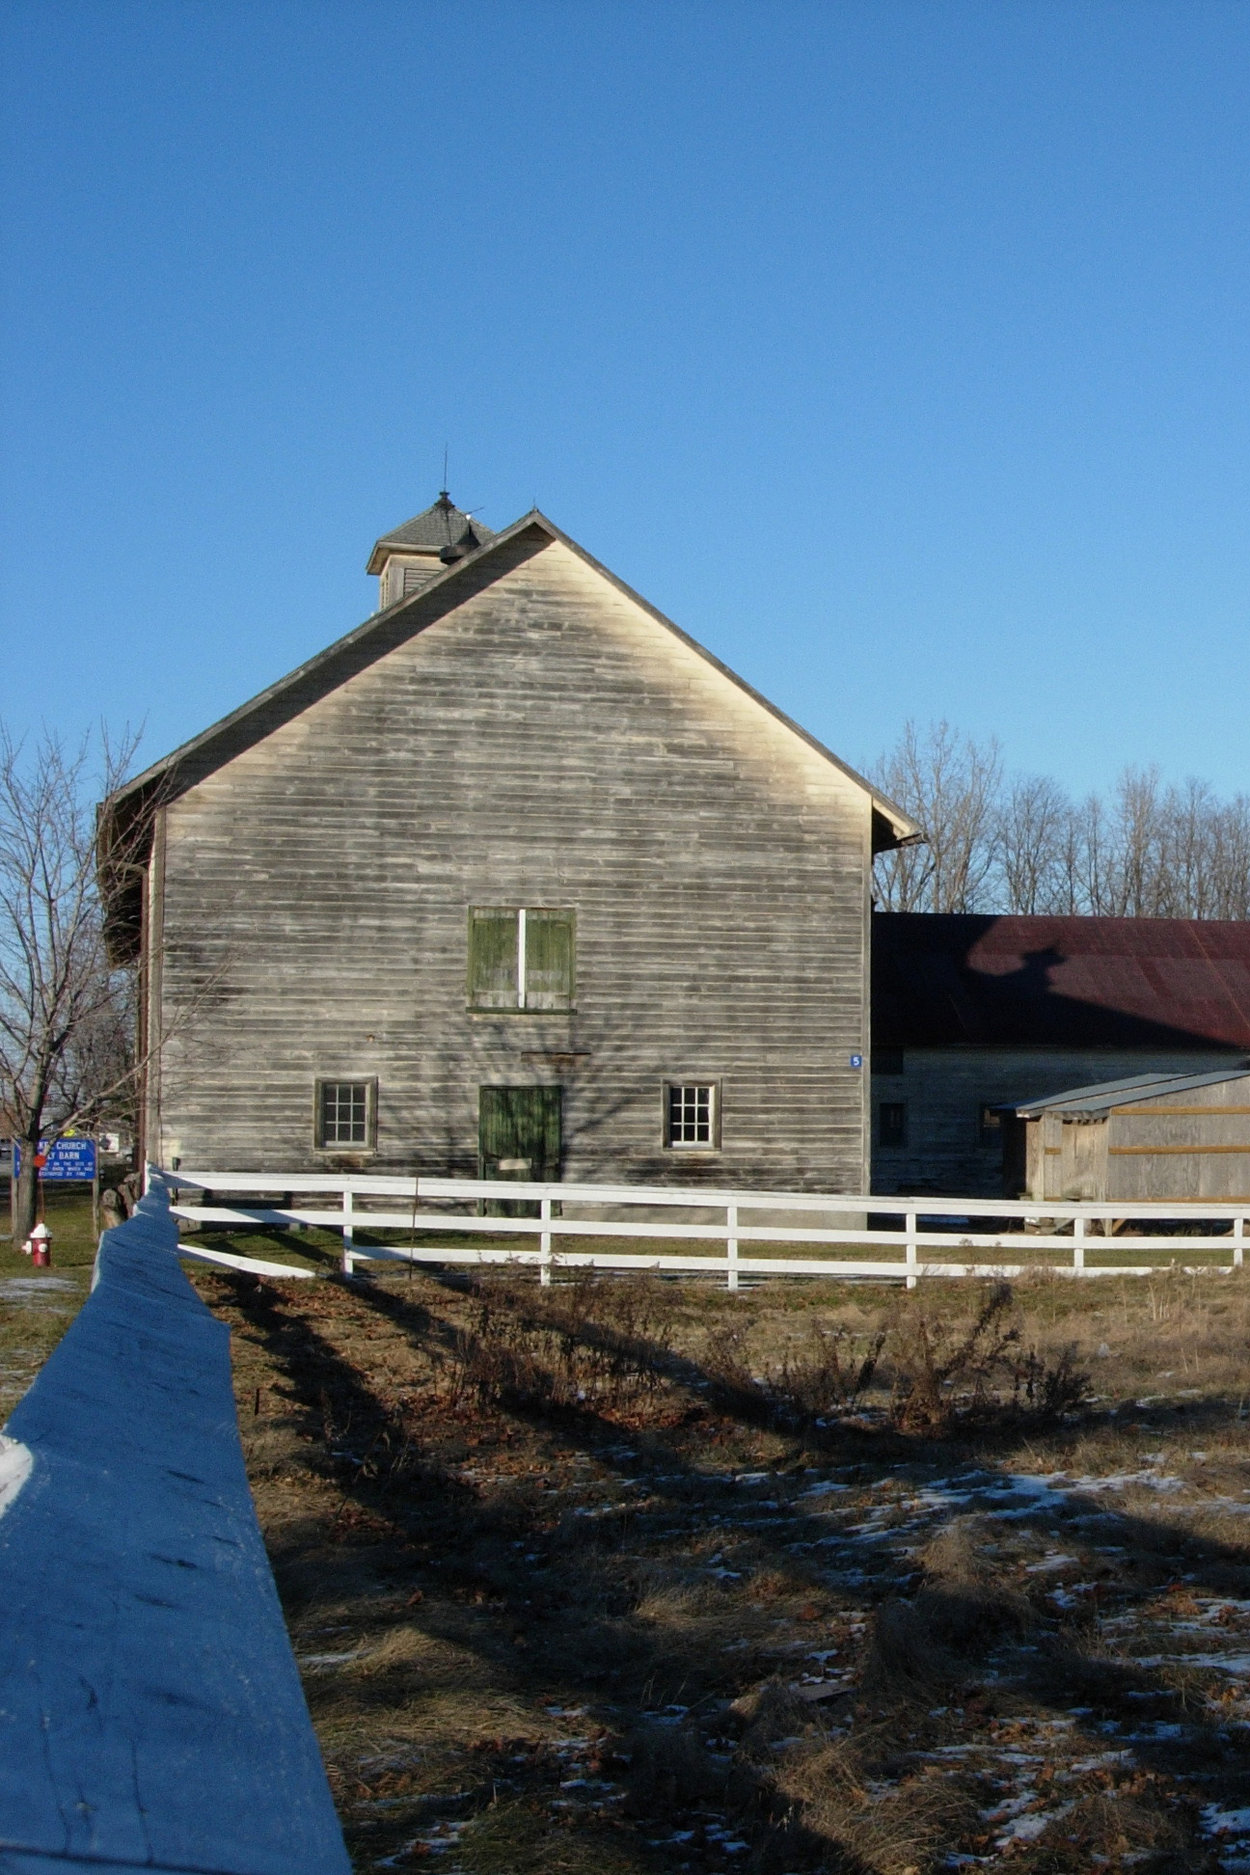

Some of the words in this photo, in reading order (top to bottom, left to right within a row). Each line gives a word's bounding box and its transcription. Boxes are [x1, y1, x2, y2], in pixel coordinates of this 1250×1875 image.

[861, 1063, 870, 1075] 5
[56, 1141, 87, 1150] CHURCH
[59, 1151, 80, 1160] BARN
